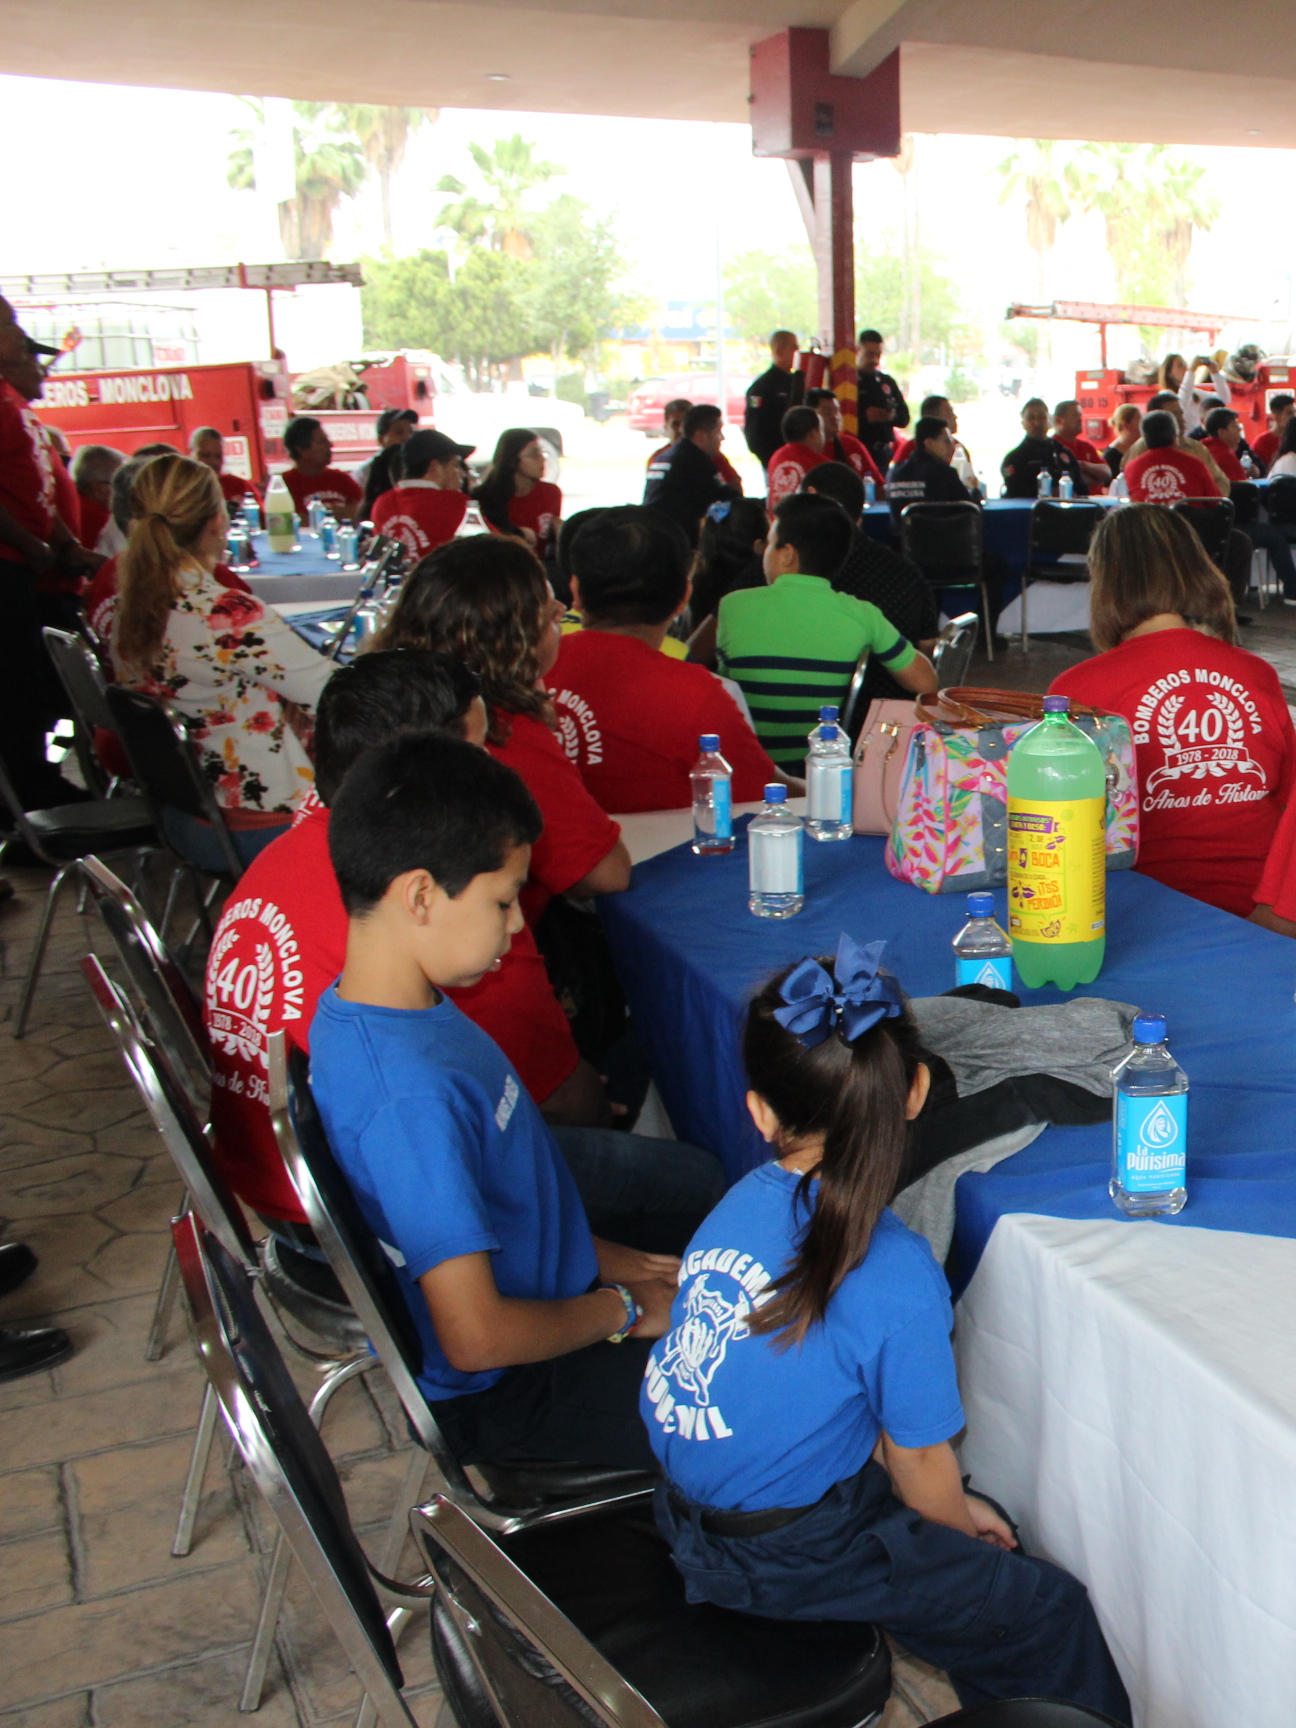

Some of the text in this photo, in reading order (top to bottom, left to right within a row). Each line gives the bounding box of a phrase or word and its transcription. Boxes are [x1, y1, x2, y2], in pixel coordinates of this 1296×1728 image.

[99, 374, 193, 405] MONCLOVA
[1153, 475, 1170, 488] 40
[1132, 668, 1262, 744] BOMBEROS MONCLOVA
[557, 689, 603, 765] MONCLOVA
[1177, 708, 1223, 743] 40
[1176, 750, 1202, 766] 1978
[1211, 748, 1239, 761] 2018
[1142, 788, 1191, 812] Años
[1192, 788, 1211, 806] de
[1031, 851, 1060, 868] BOCA
[259, 902, 303, 1020] MONCLOVA
[217, 957, 259, 1010] 40
[1137, 1144, 1148, 1156] La
